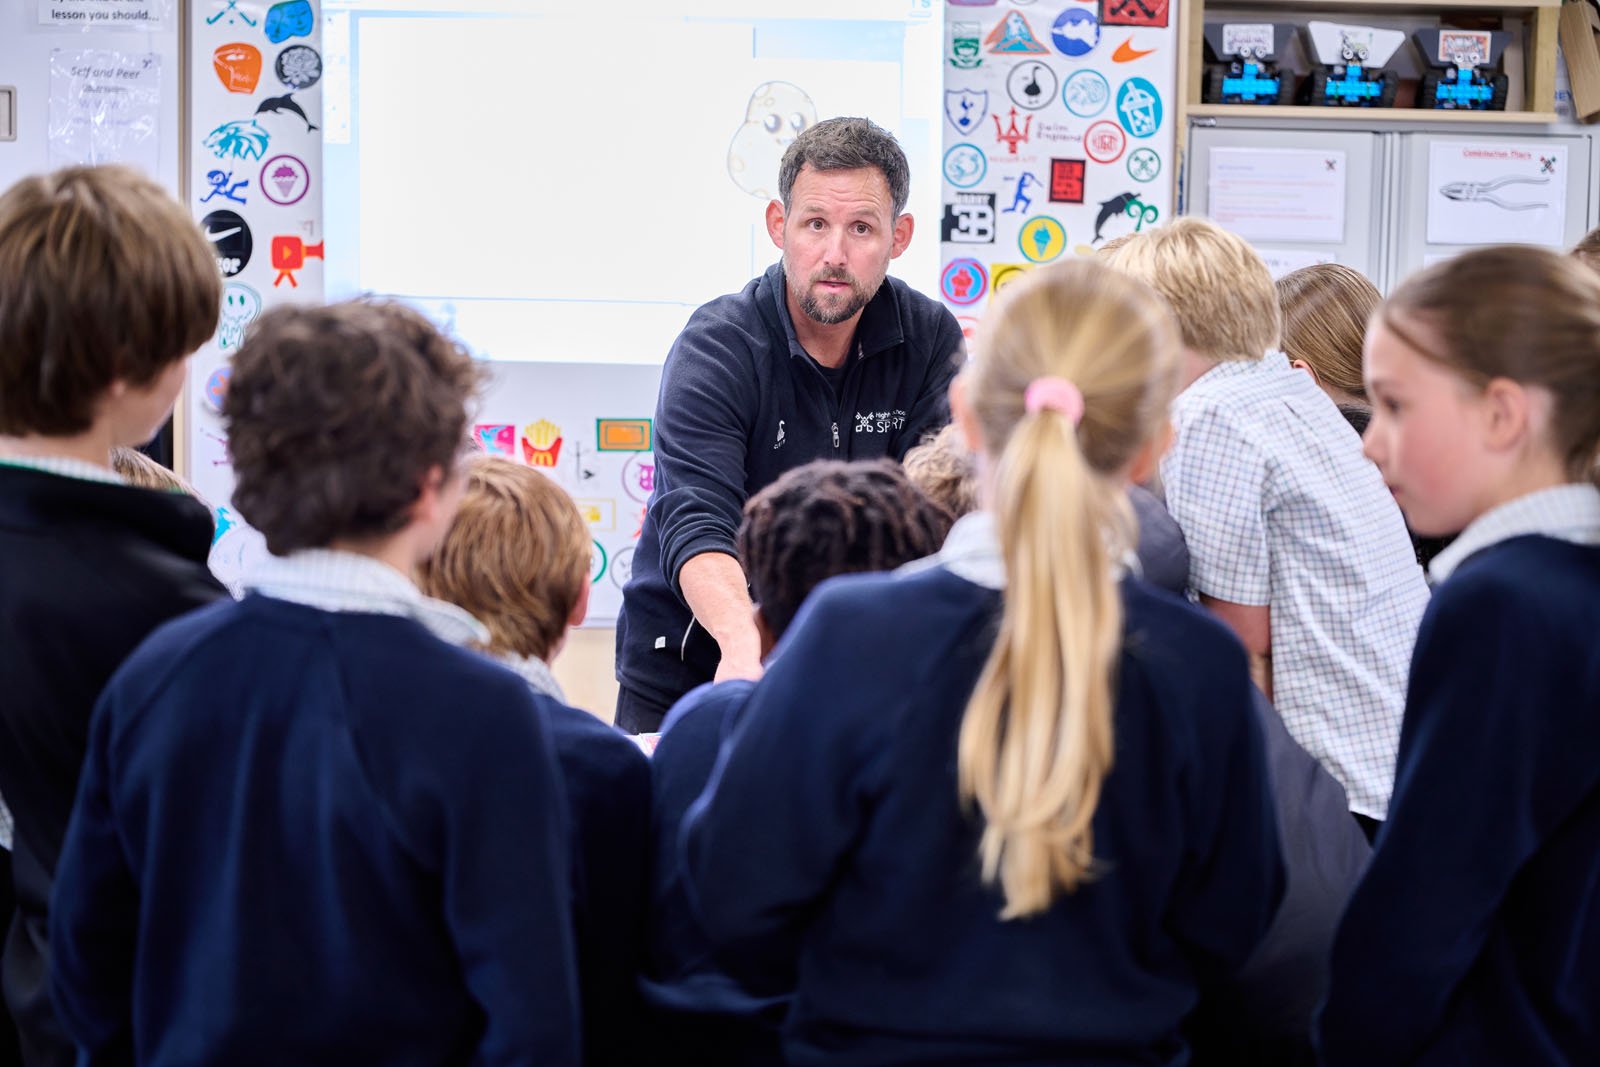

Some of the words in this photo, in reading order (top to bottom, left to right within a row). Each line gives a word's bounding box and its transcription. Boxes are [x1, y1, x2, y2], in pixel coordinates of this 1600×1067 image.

[51, 9, 86, 20] lesson
[88, 10, 109, 21] you
[116, 68, 141, 80] Peer
